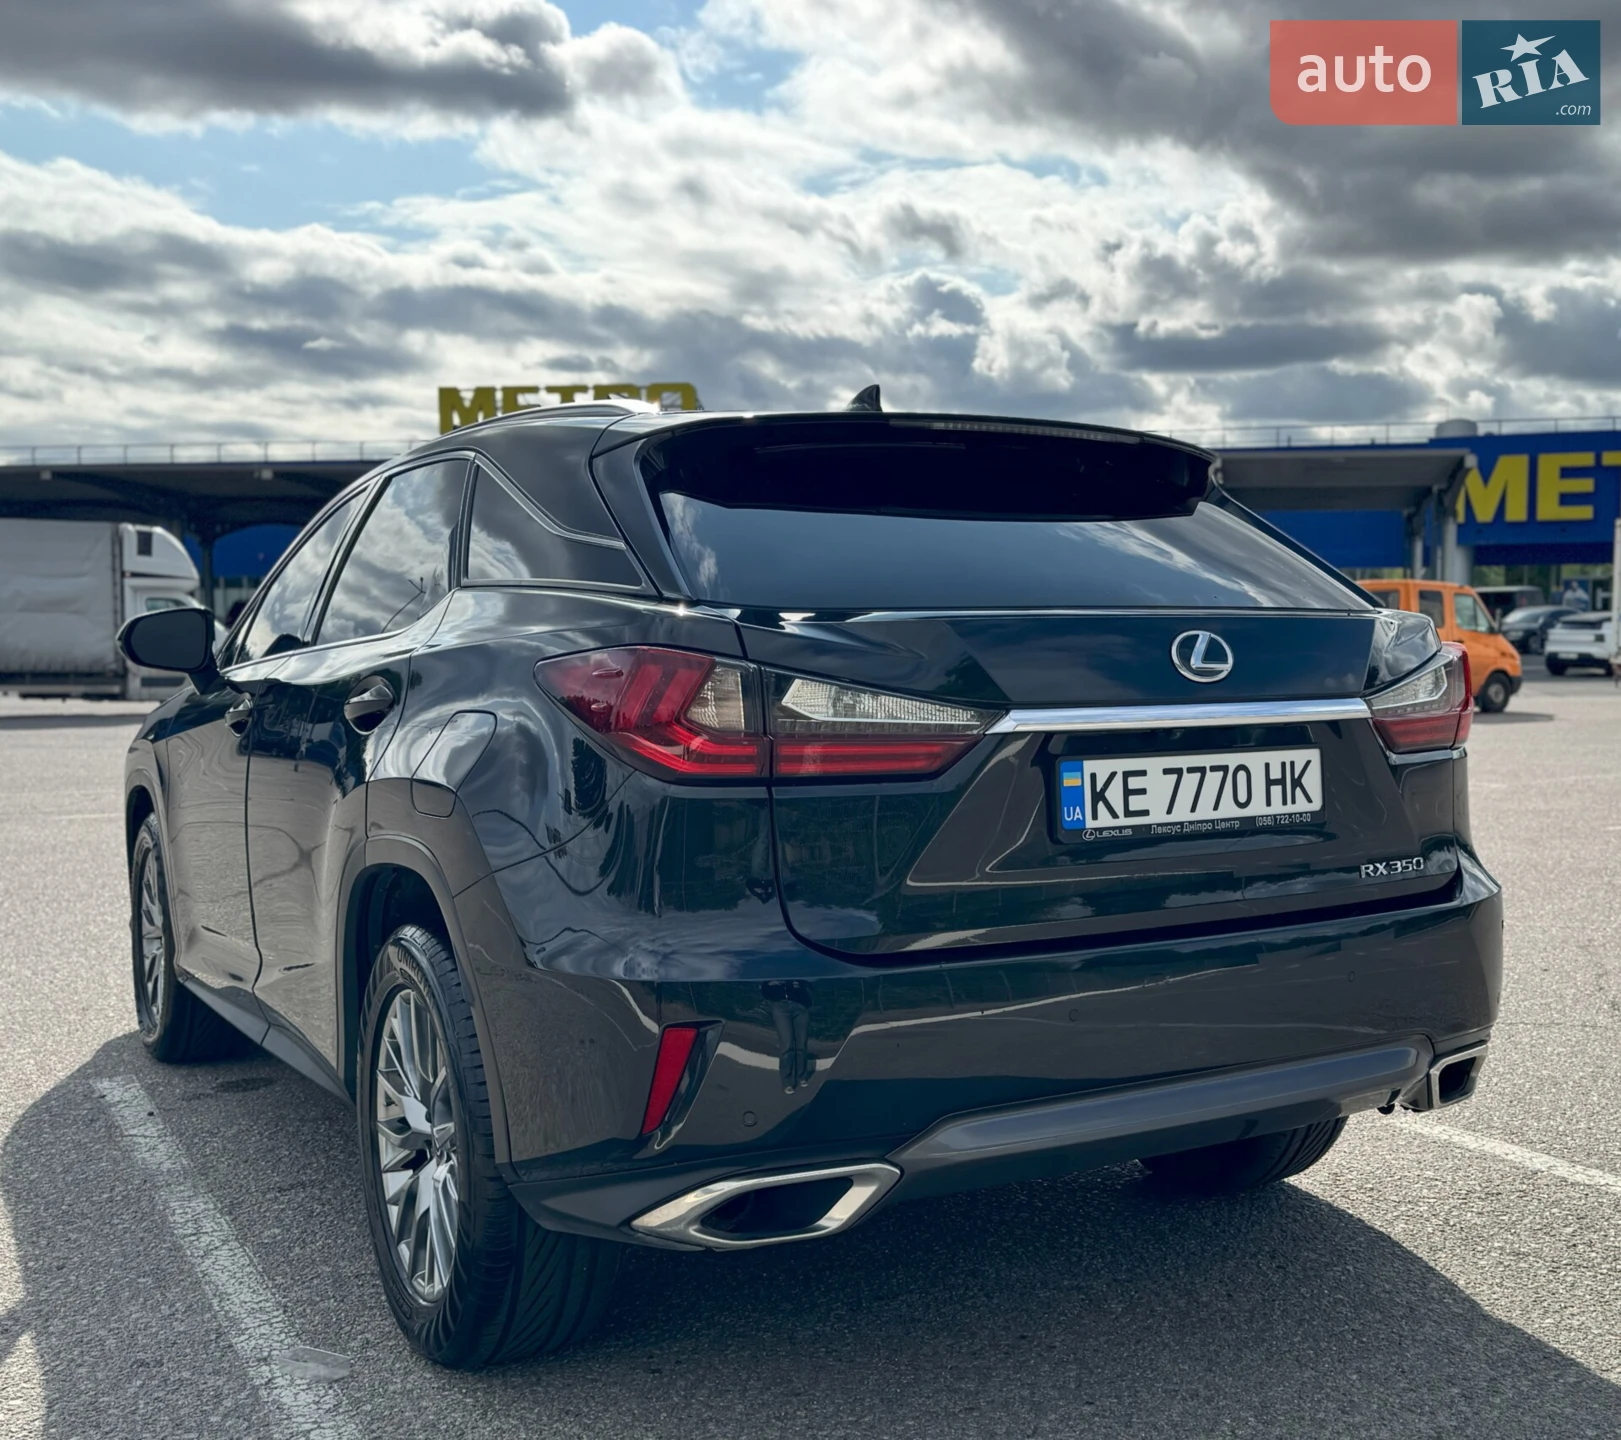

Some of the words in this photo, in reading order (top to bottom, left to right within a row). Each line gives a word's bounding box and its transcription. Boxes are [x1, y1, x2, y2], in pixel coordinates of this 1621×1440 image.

[1089, 769, 1150, 821] KE
[1162, 763, 1253, 815] 7770
[1264, 759, 1314, 807] HK
[1064, 806, 1083, 821] UA
[1276, 813, 1312, 824] 722-10-00
[1096, 829, 1132, 838] LEXUS
[1360, 861, 1389, 879] RX
[1389, 857, 1424, 875] 350
